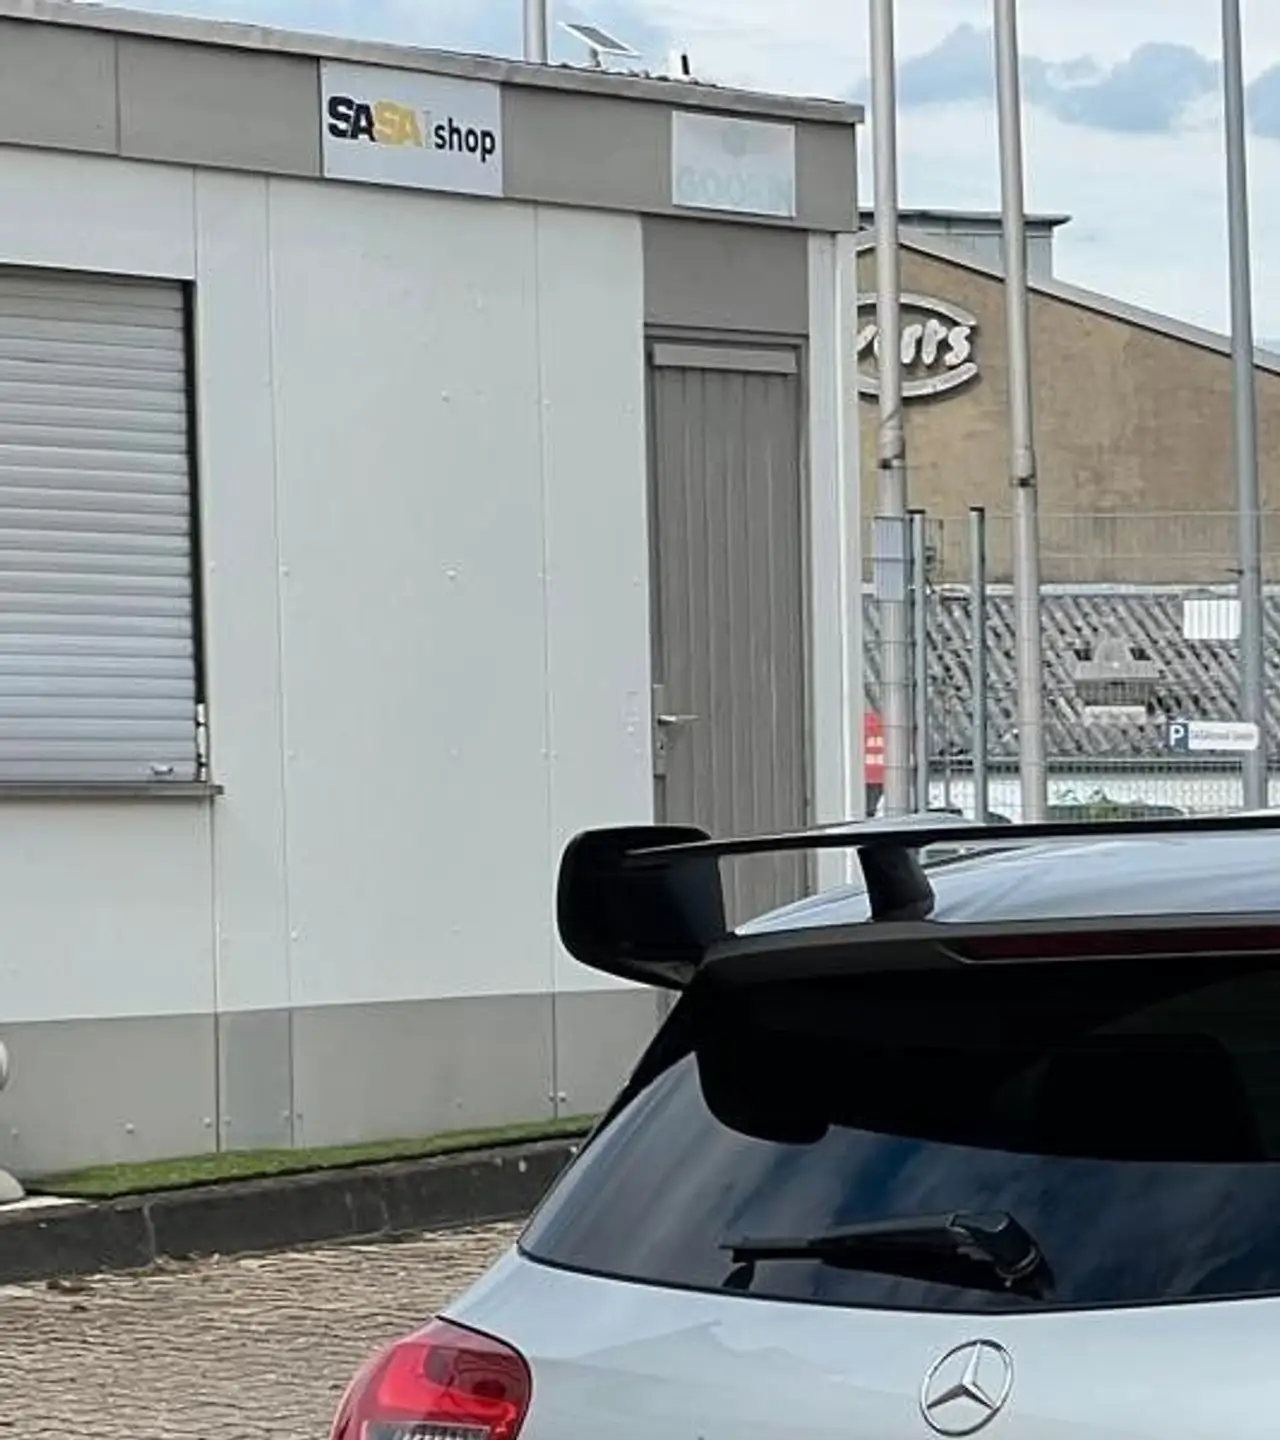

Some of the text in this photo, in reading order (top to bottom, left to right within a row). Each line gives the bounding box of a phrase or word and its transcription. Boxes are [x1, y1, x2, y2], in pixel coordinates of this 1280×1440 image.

[327, 96, 496, 164] SASA shop
[1170, 725, 1184, 746] P
